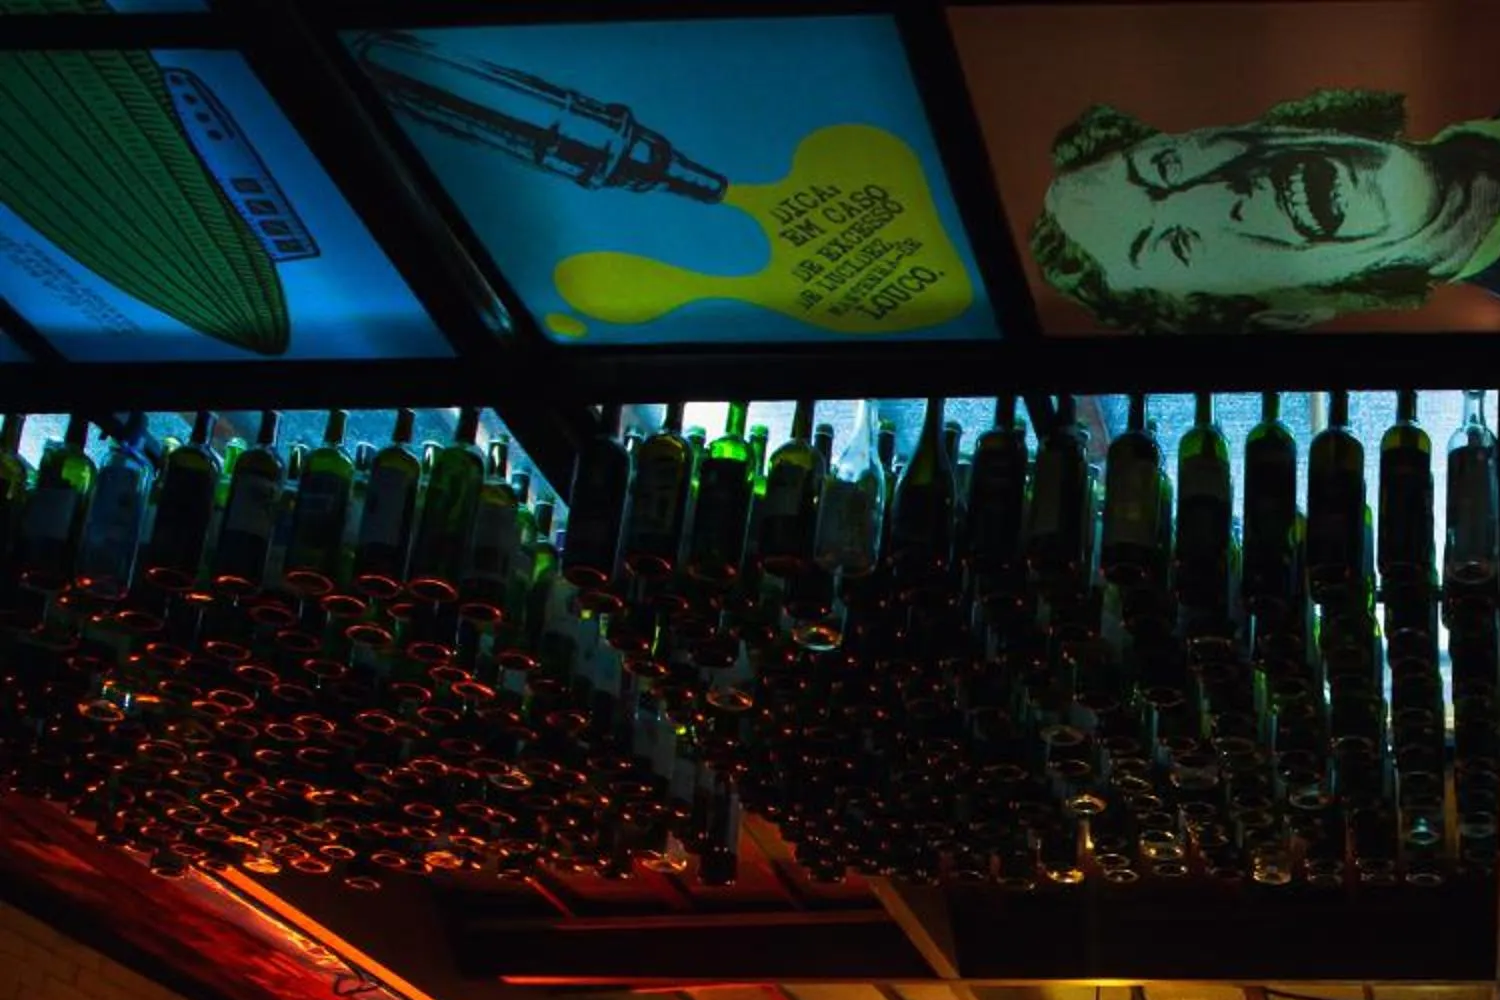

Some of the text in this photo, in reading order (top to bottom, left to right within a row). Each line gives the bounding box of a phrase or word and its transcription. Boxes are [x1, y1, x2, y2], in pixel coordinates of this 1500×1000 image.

[779, 183, 891, 248] EM CASO
[792, 200, 906, 282] DE EXCESSO
[855, 268, 946, 320] LOUCO.
